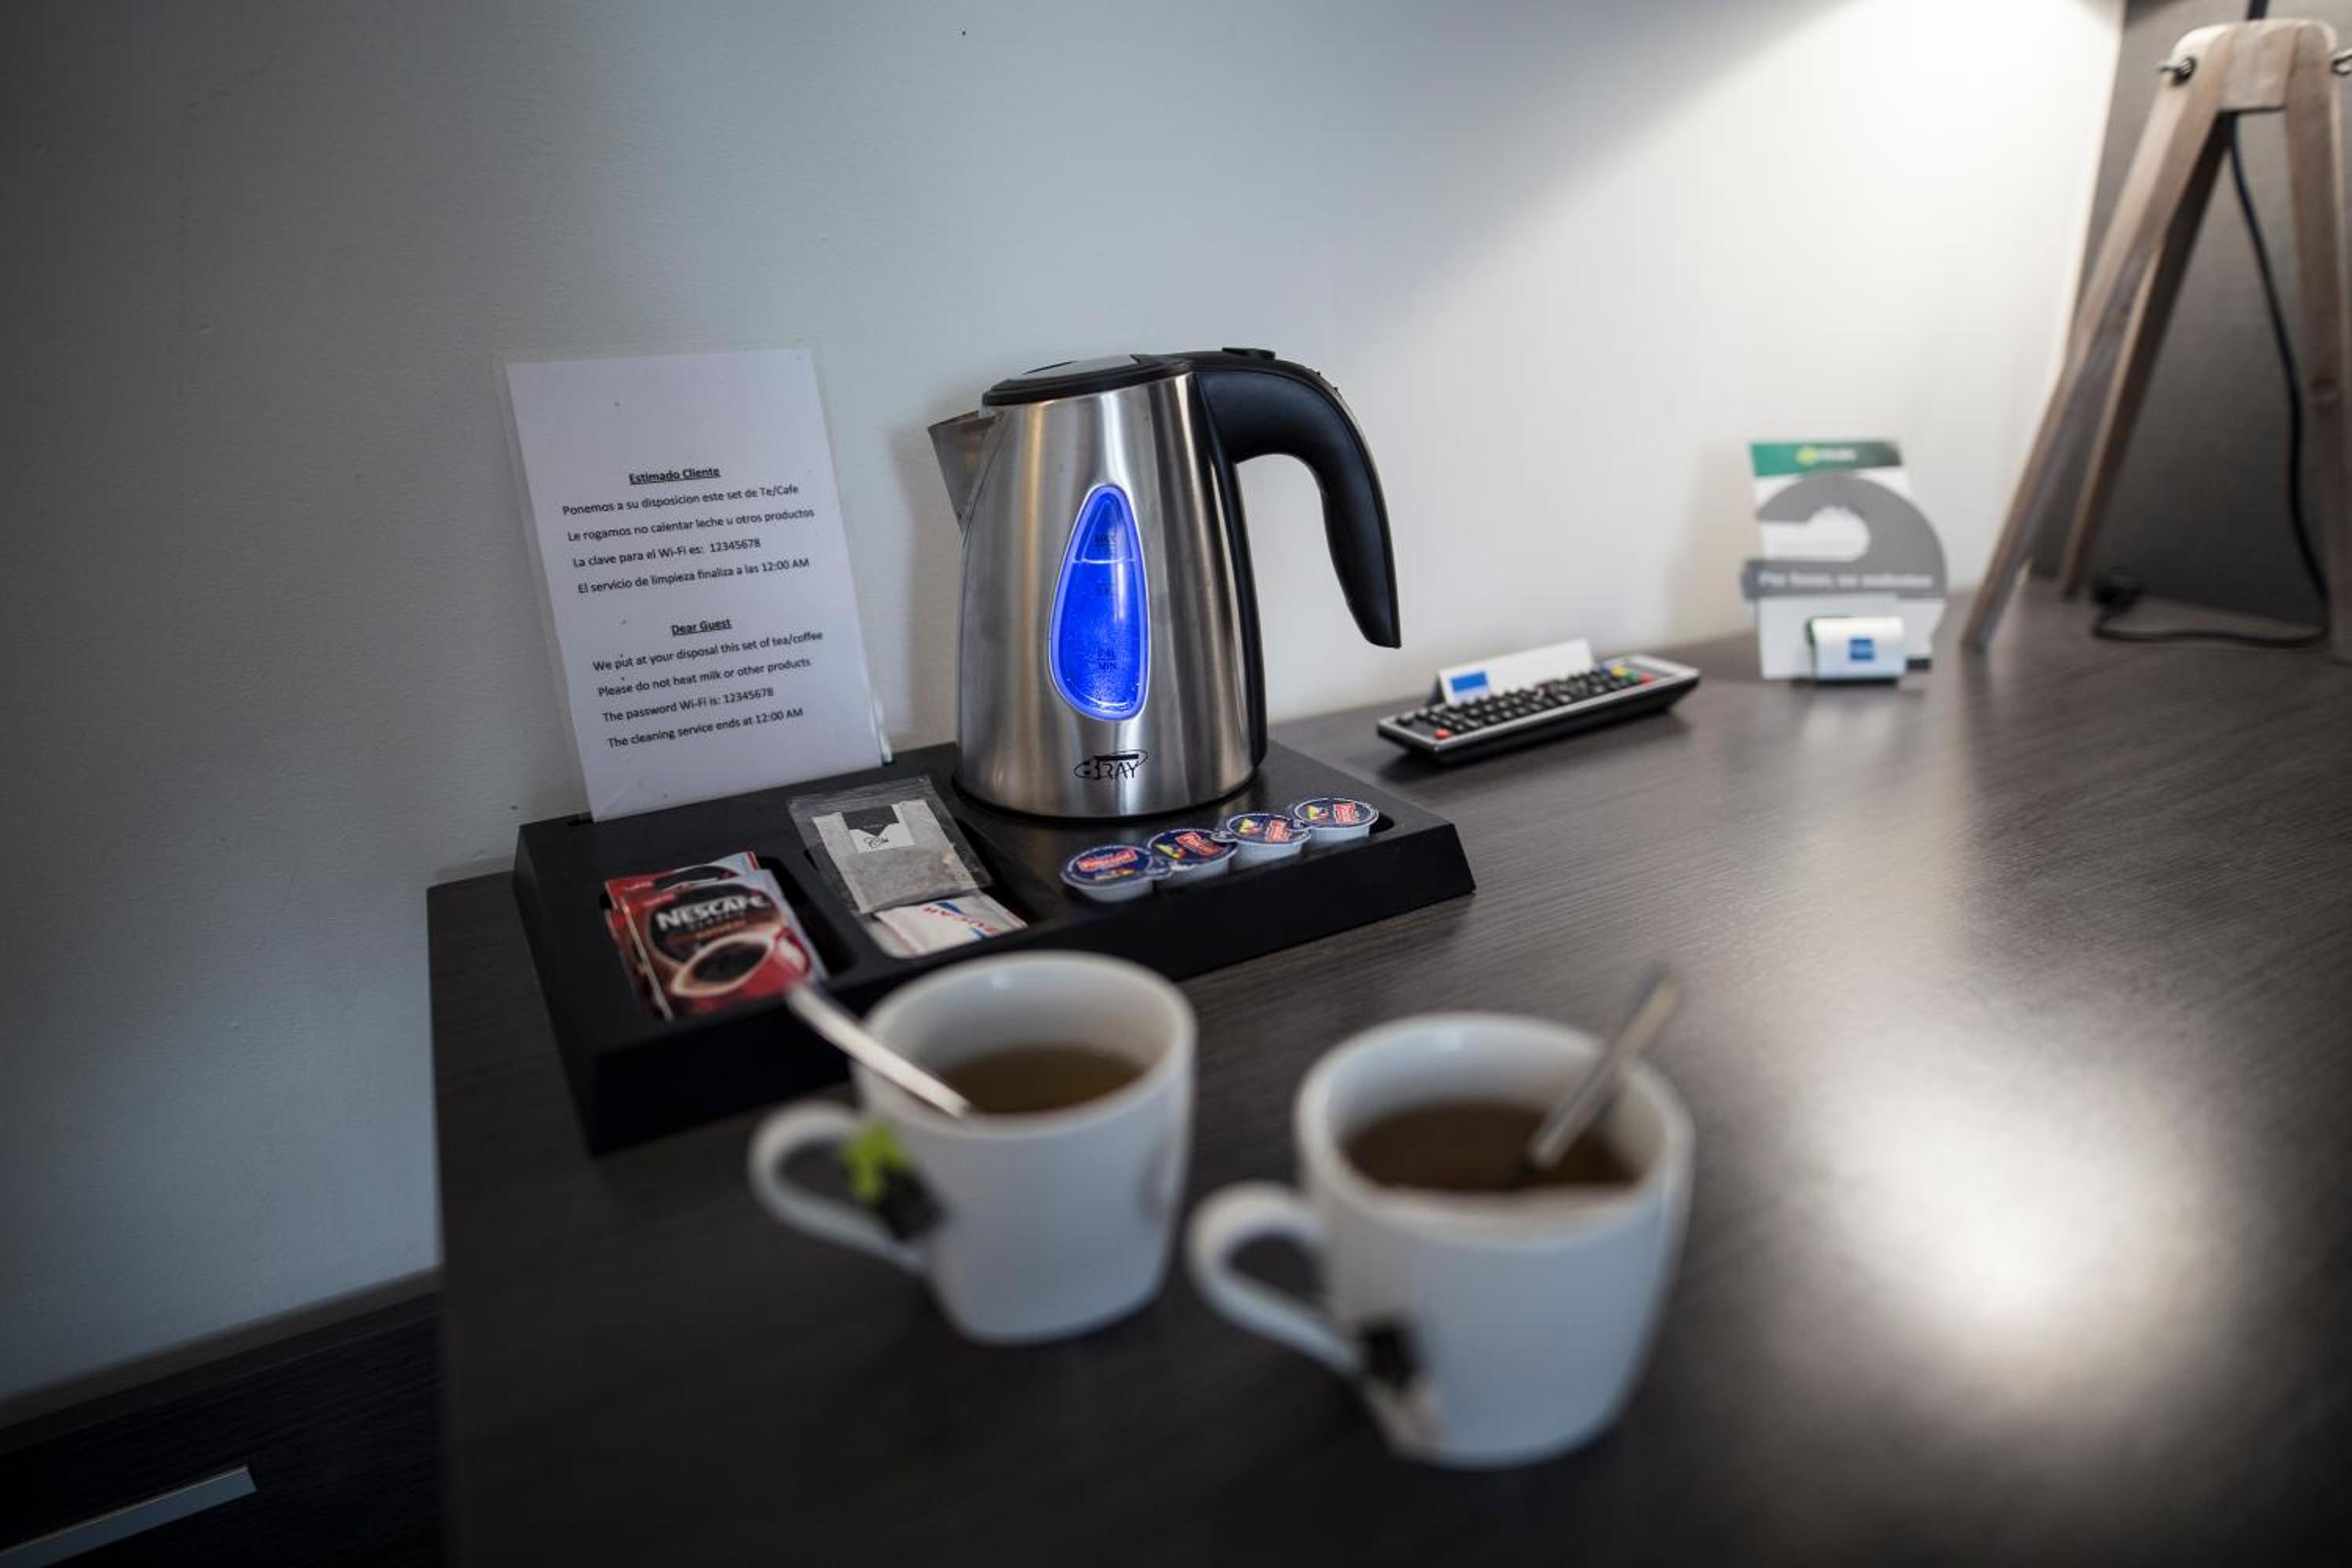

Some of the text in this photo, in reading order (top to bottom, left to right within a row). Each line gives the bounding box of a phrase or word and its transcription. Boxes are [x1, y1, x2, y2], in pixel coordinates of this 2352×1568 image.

[629, 467, 721, 486] Estimado Cliente
[561, 503, 615, 516] Ponemos
[626, 501, 640, 510] su
[641, 495, 701, 509] disposicion
[702, 492, 725, 503] este
[726, 490, 743, 501] set
[744, 488, 759, 499] de
[758, 484, 799, 497] Te/Cafe
[567, 509, 815, 543] Le rogamos no calentar leche u otros productos
[572, 538, 761, 568] La clave para el Wi-Fi es: 12345678
[577, 557, 811, 594] El servicio de limpieza finaliza a las 12:00 AM
[671, 619, 731, 637] Dear Guest
[592, 630, 823, 672] We put at your disposal this set of tea/coffee
[597, 658, 811, 697] Please do not heat milk or other products
[601, 687, 775, 722] The password Wi-Fi is: 12345678
[607, 707, 804, 749] The cleaning service ends at 12:00 AM
